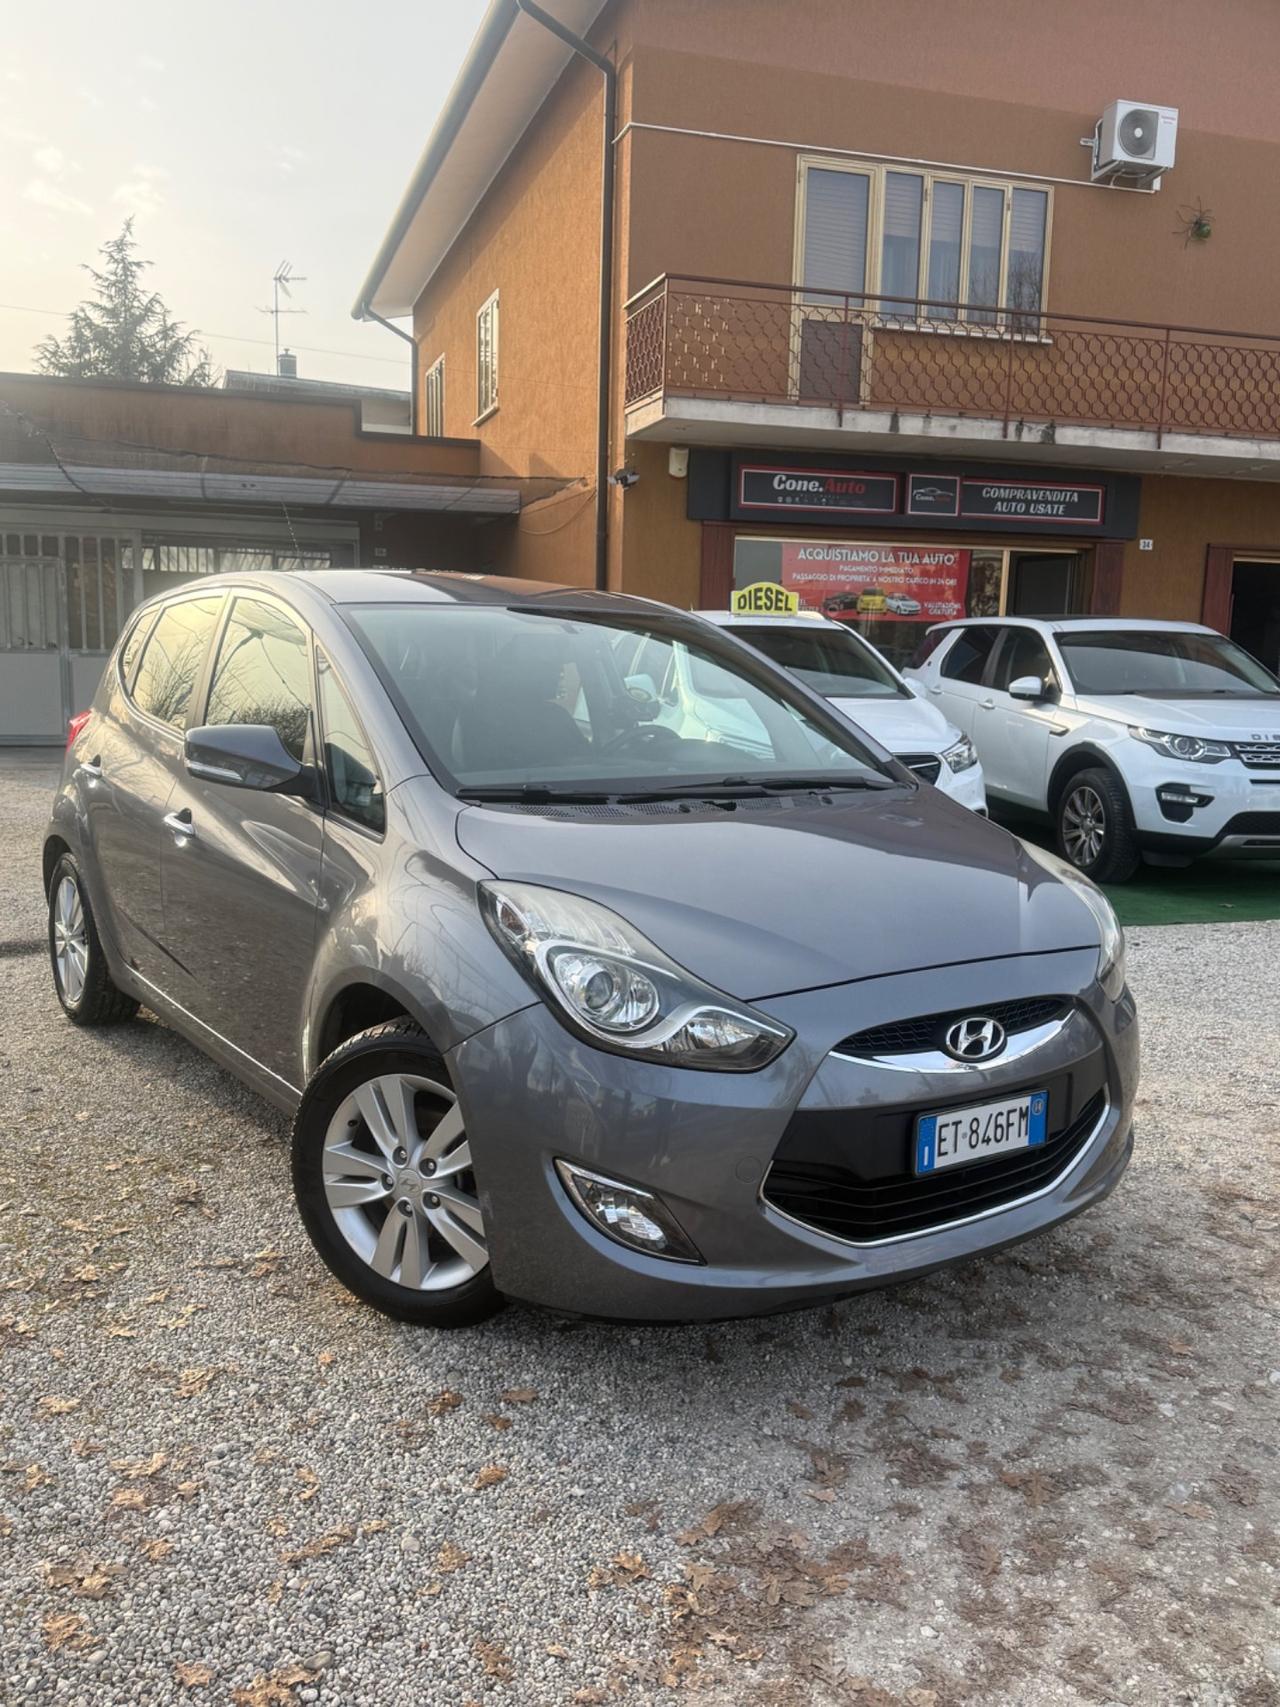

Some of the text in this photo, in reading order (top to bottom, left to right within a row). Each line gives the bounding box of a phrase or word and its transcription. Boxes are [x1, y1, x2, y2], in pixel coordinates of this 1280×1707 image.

[982, 486, 1079, 503] COMPRAVENDITA
[994, 501, 1066, 516] AUTO USATE
[798, 548, 955, 565] ACQUISTIAMO LA TUA AUTO
[839, 564, 878, 573] PAGAMENTO
[878, 576, 904, 584] NOSTRO
[737, 587, 793, 611] DIESEL
[937, 1120, 962, 1157] ET
[968, 1106, 1029, 1148] 846FM
